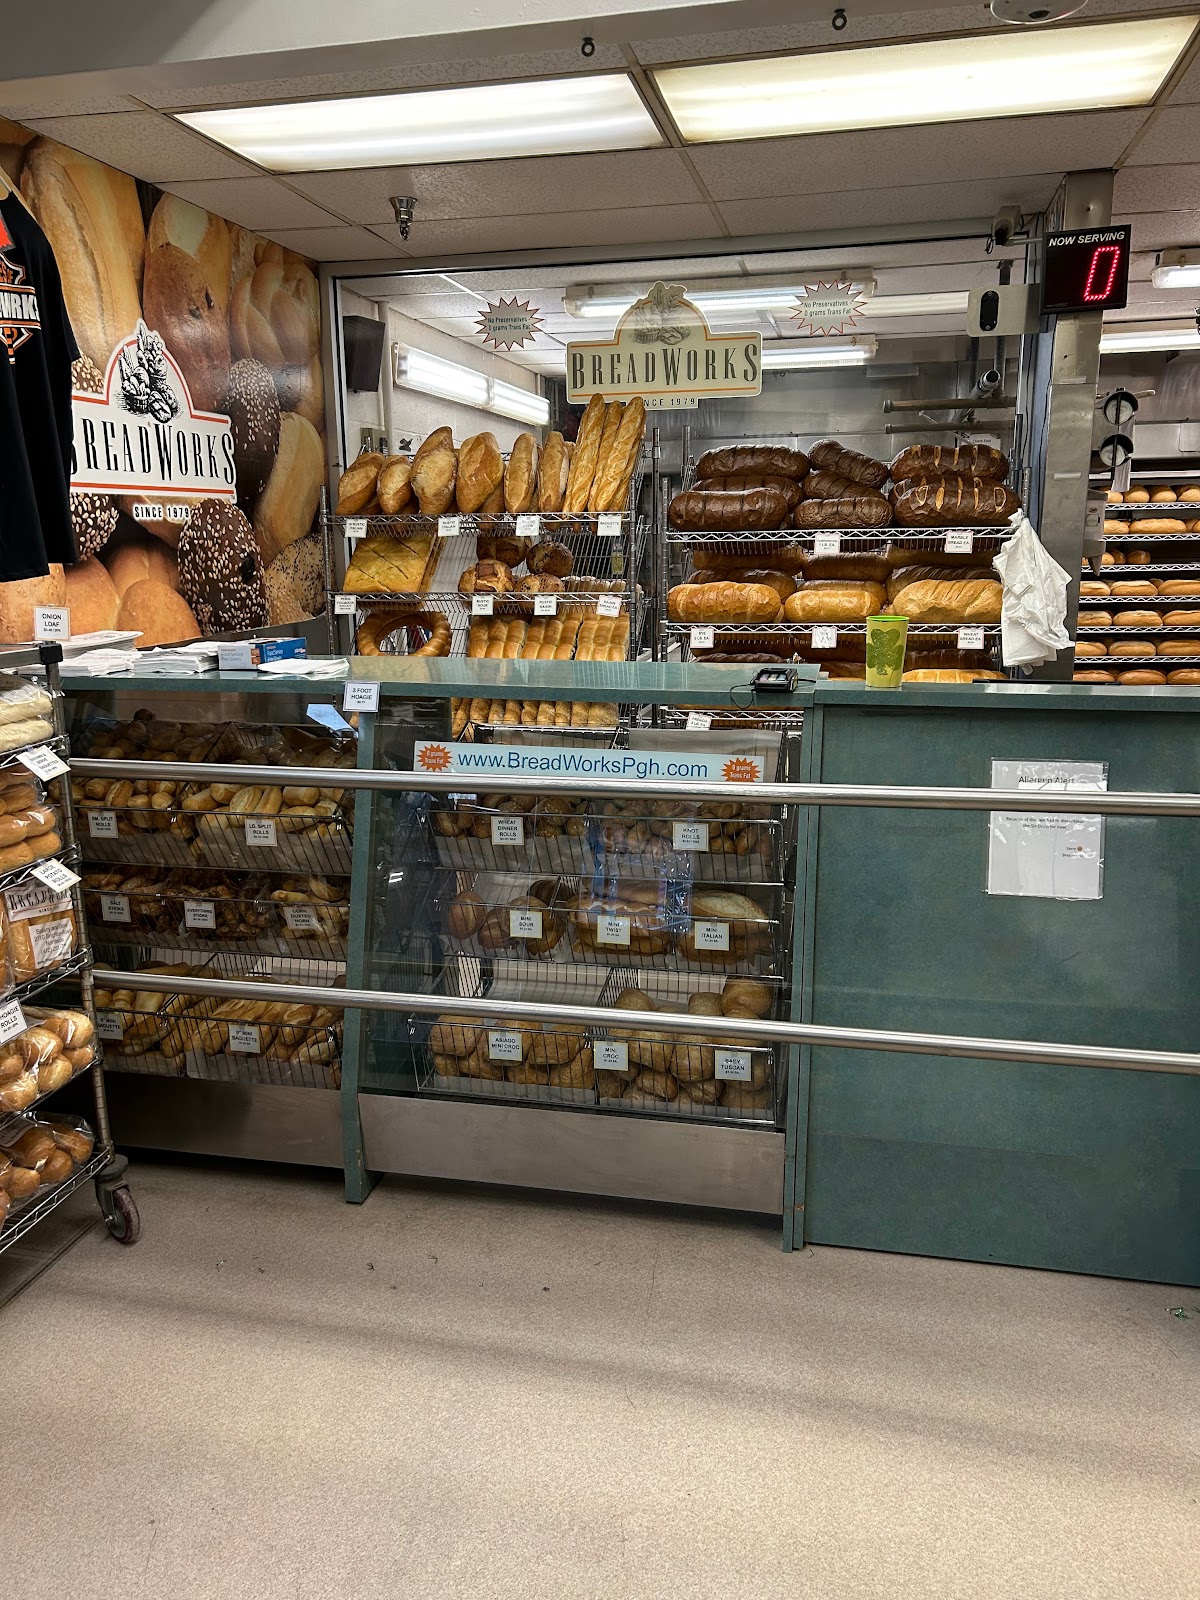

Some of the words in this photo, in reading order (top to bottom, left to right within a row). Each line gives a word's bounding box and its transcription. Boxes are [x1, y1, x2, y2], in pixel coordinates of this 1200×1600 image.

[1049, 235, 1075, 247] NOW
[1077, 230, 1125, 244] SERVING
[1083, 246, 1120, 302] 0
[812, 300, 849, 308] Preservatives
[809, 310, 826, 318] grams
[572, 343, 759, 389] BREADWORKS
[670, 396, 696, 408] 1979
[133, 504, 162, 519] SINCE
[166, 504, 190, 519] 1979
[457, 751, 709, 779] www.BreadWorksPgh.com
[1018, 776, 1052, 784] Allergen
[1054, 776, 1075, 784] Alert
[39, 864, 56, 875] LARGE
[44, 868, 63, 879] POTATO
[52, 874, 68, 883] ROLLS
[36, 926, 50, 934] Bakery
[0, 1015, 18, 1028] ROLLS
[232, 1035, 258, 1043] BAGUETTE
